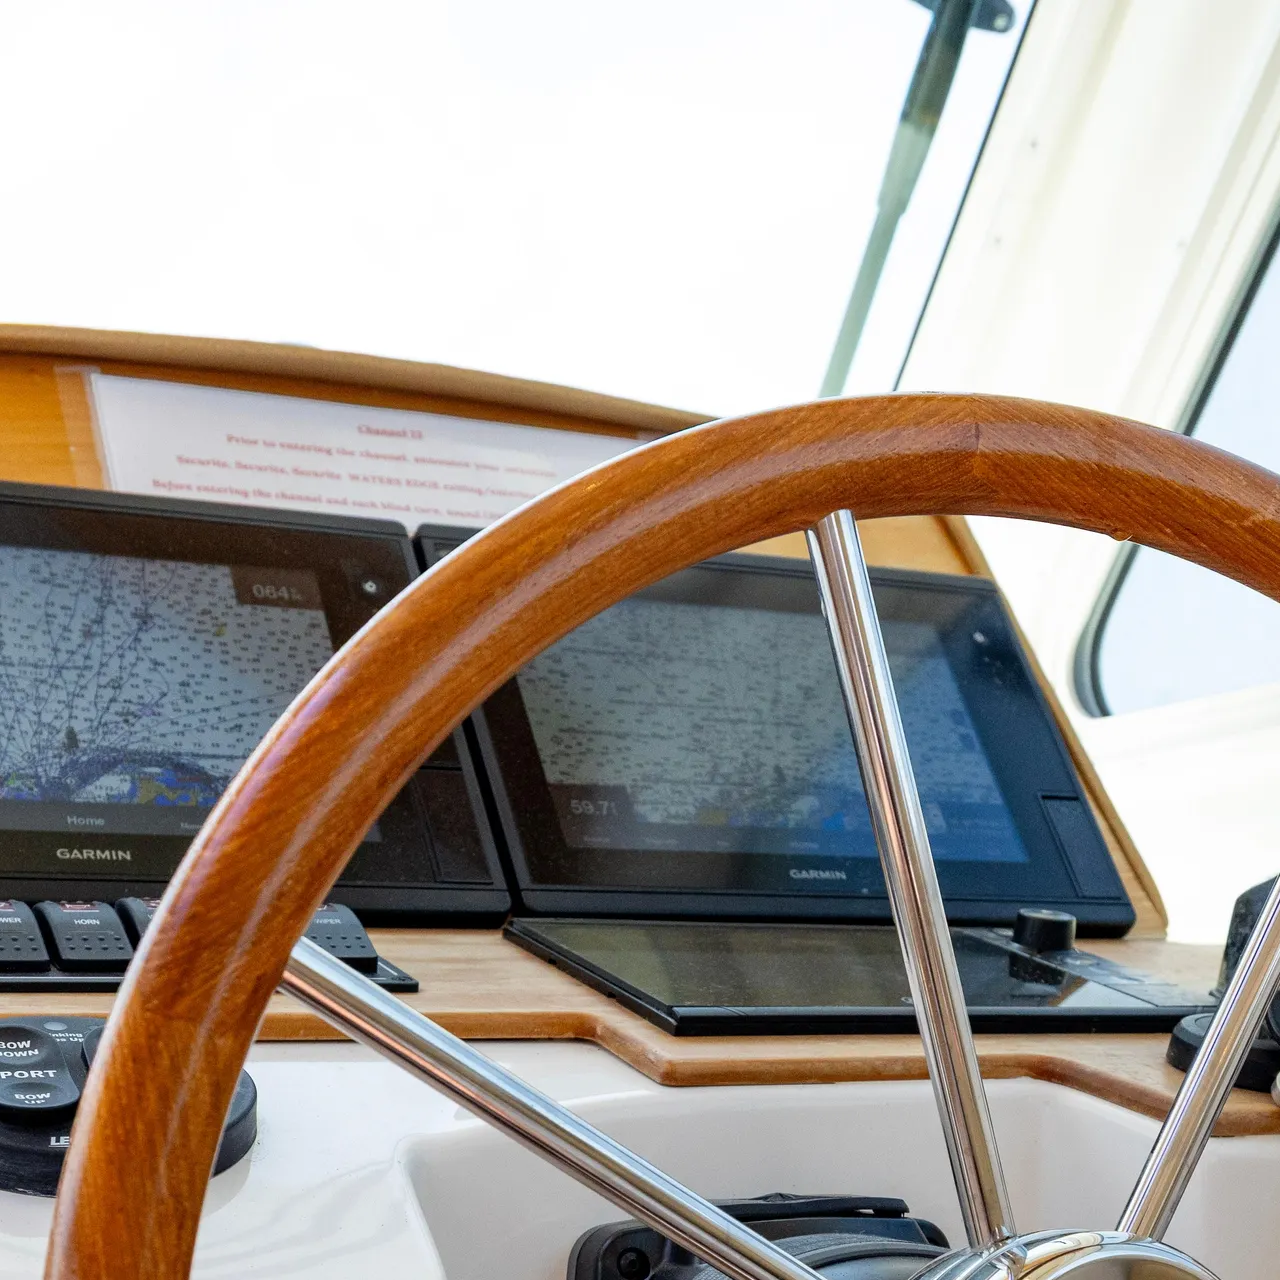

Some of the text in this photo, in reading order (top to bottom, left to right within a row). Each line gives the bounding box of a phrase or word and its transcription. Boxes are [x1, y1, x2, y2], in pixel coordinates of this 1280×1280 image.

[67, 815, 106, 826] Home
[56, 848, 132, 861] GARMIN
[789, 869, 847, 880] GARMIN
[0, 1070, 57, 1079] PORT
[14, 1092, 51, 1100] BOW
